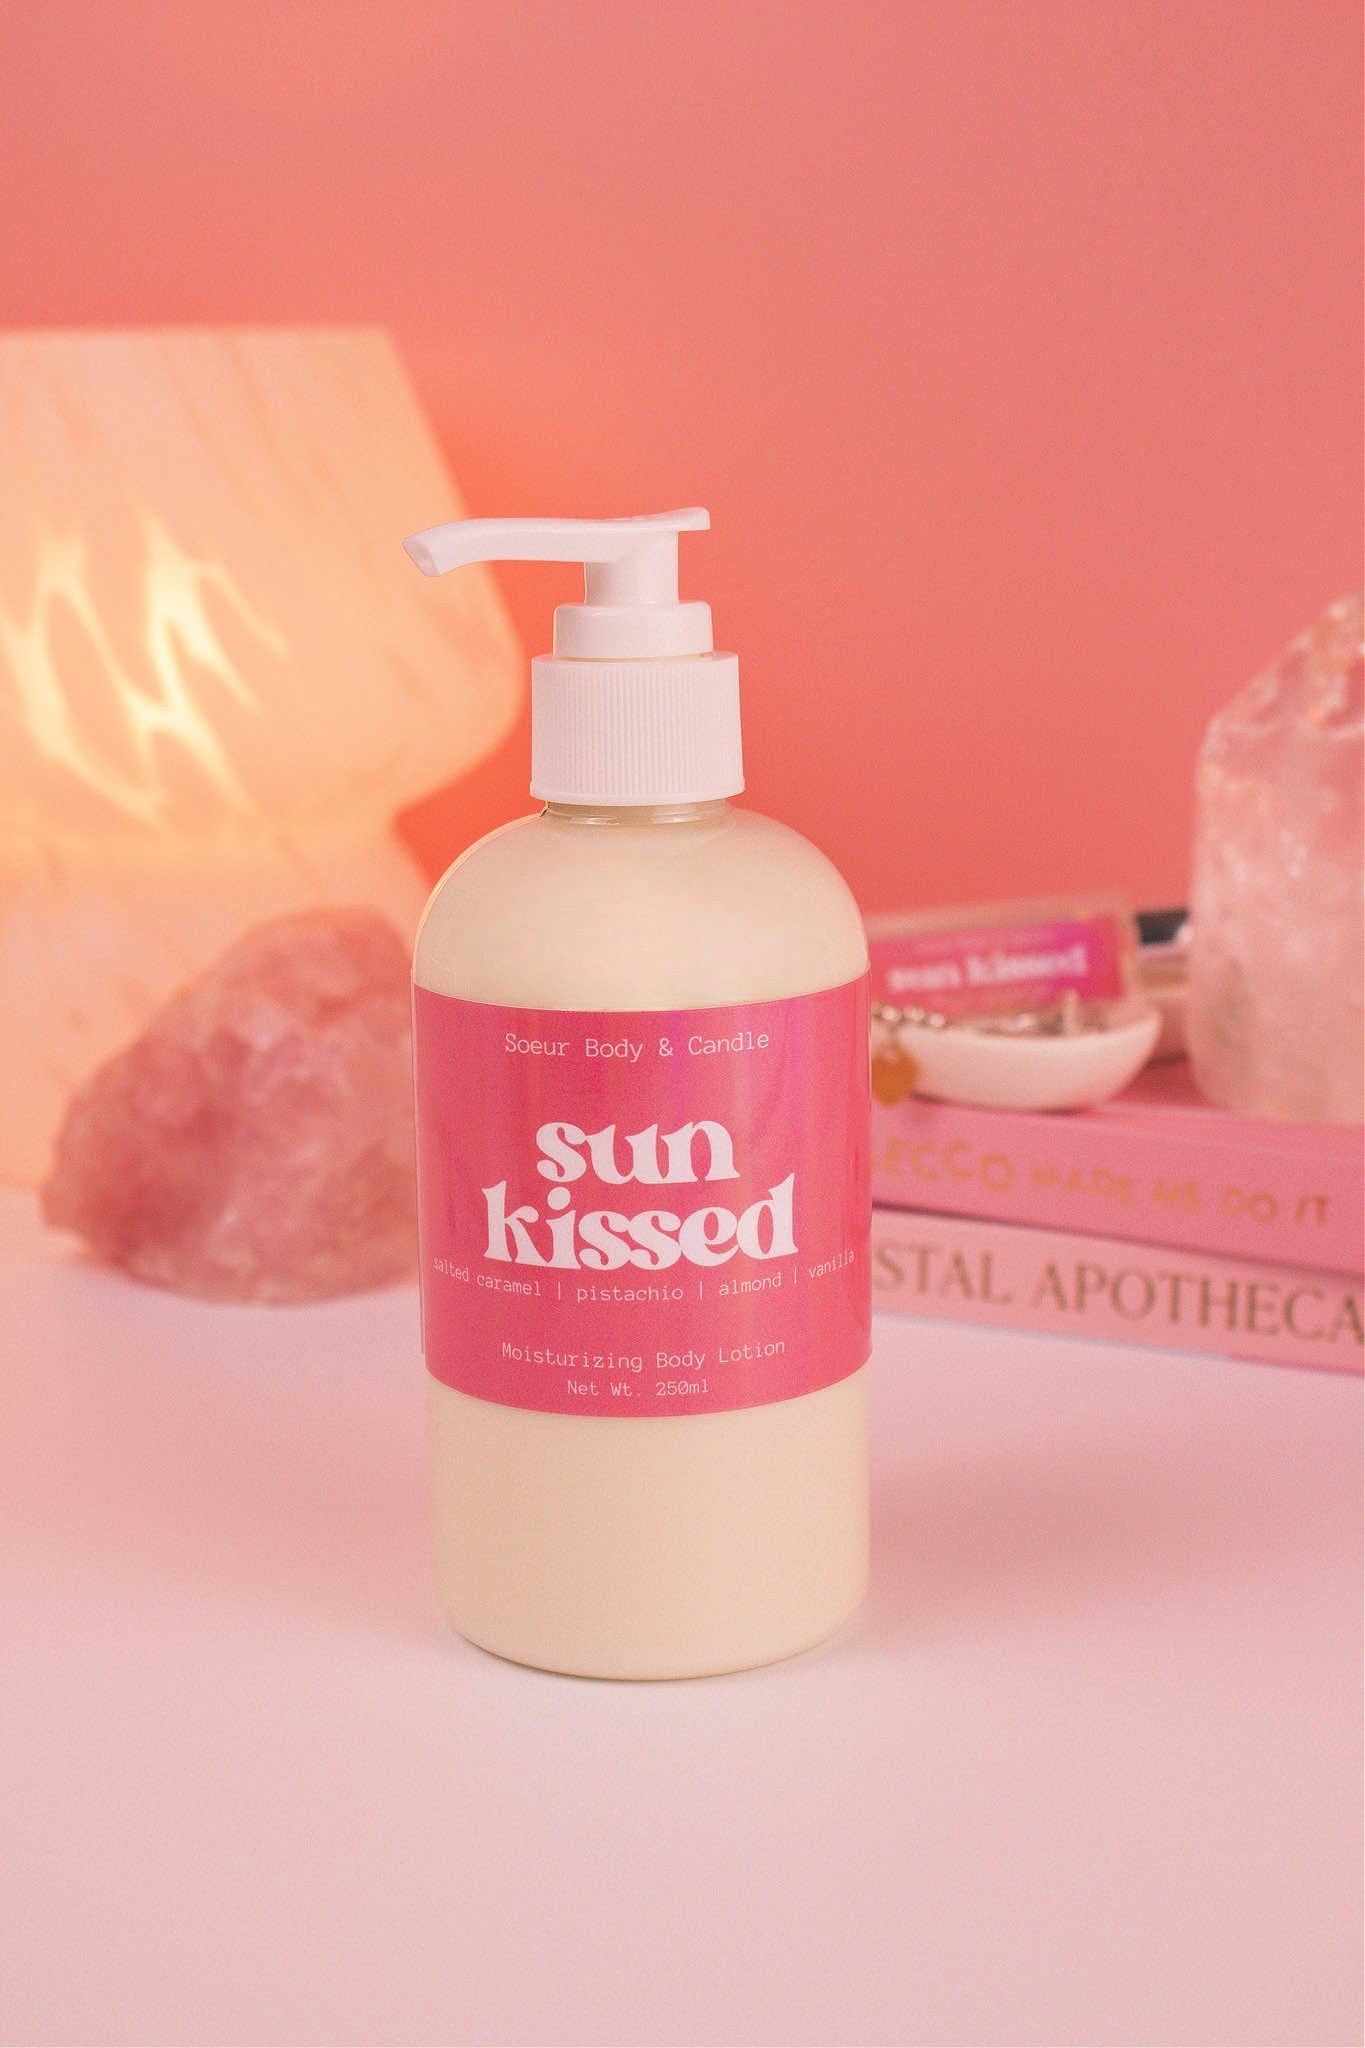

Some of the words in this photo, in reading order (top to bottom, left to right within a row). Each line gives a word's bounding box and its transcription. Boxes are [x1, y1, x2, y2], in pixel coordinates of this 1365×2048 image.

[504, 1032, 568, 1057] Soeur
[585, 1038, 644, 1063] Body
[658, 1039, 673, 1057] &
[687, 1031, 770, 1055] Candle
[536, 1120, 741, 1185] sun
[872, 1135, 1014, 1192] ECCO
[1222, 1186, 1280, 1225] DO
[1294, 1194, 1333, 1227] IT
[481, 1172, 799, 1271] kissed
[433, 1256, 470, 1283] salted
[476, 1273, 542, 1297] caramel
[576, 1283, 684, 1303] pistachio
[718, 1271, 783, 1297] almond
[808, 1248, 856, 1281] vanilla
[872, 1241, 1016, 1305] STAL
[1032, 1256, 1365, 1345] APOTHECA
[501, 1341, 643, 1372] Moisturizing
[655, 1351, 704, 1371] Body
[718, 1338, 787, 1364] Lotion
[566, 1379, 599, 1396] Net
[610, 1382, 640, 1398] Wt.
[655, 1378, 710, 1397] 250ml
